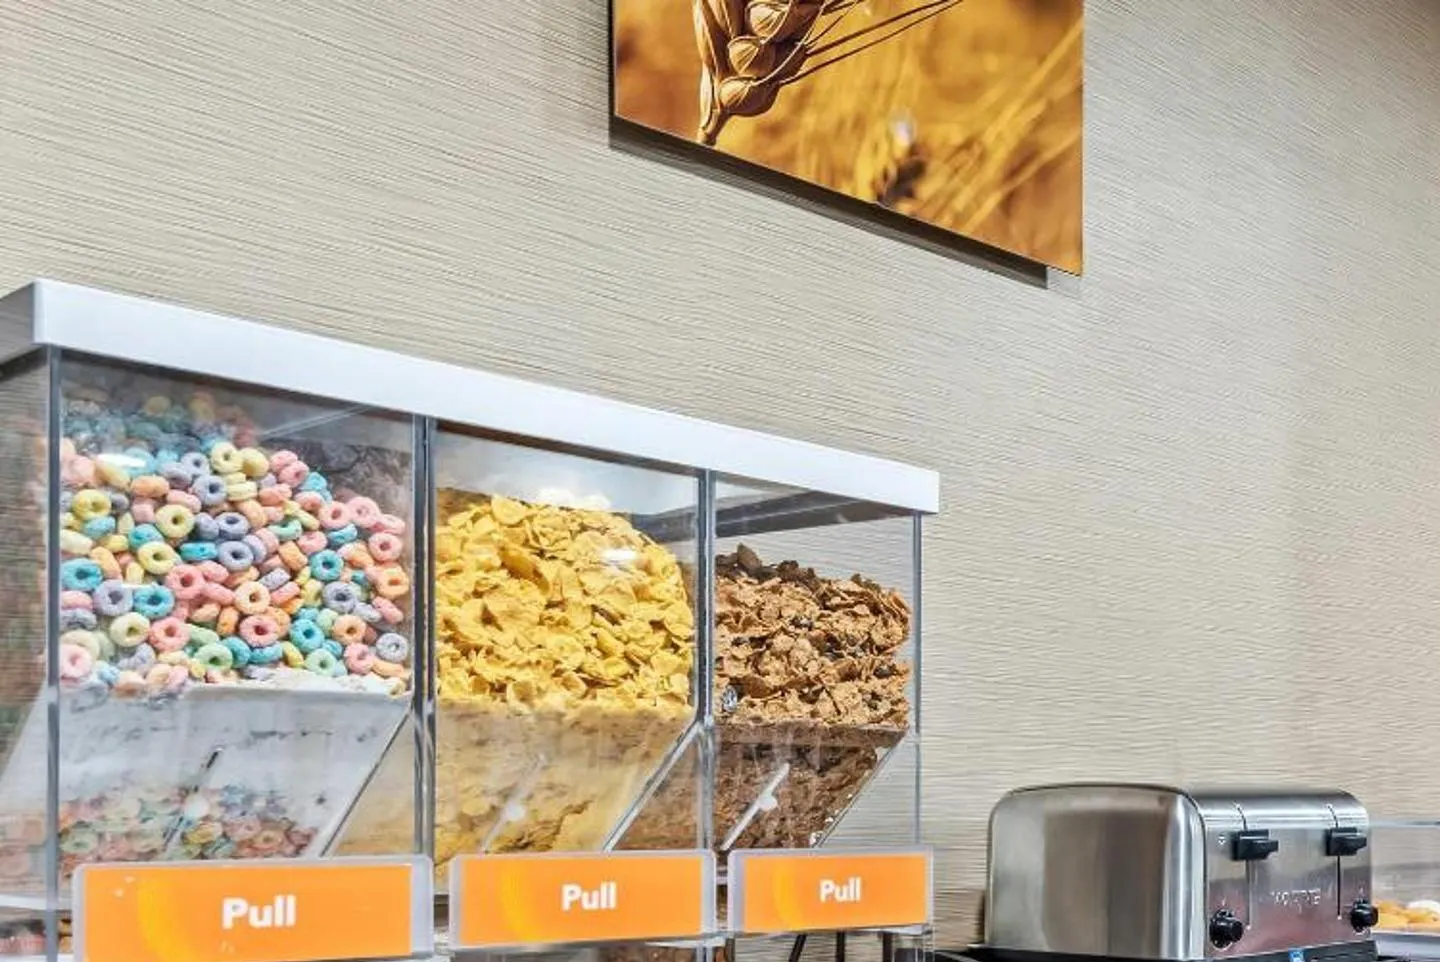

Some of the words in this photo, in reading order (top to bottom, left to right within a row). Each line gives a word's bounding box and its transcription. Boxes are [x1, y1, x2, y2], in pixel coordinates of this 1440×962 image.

[562, 880, 617, 911] Pull
[820, 876, 862, 903] Pull
[222, 894, 297, 930] Pull
